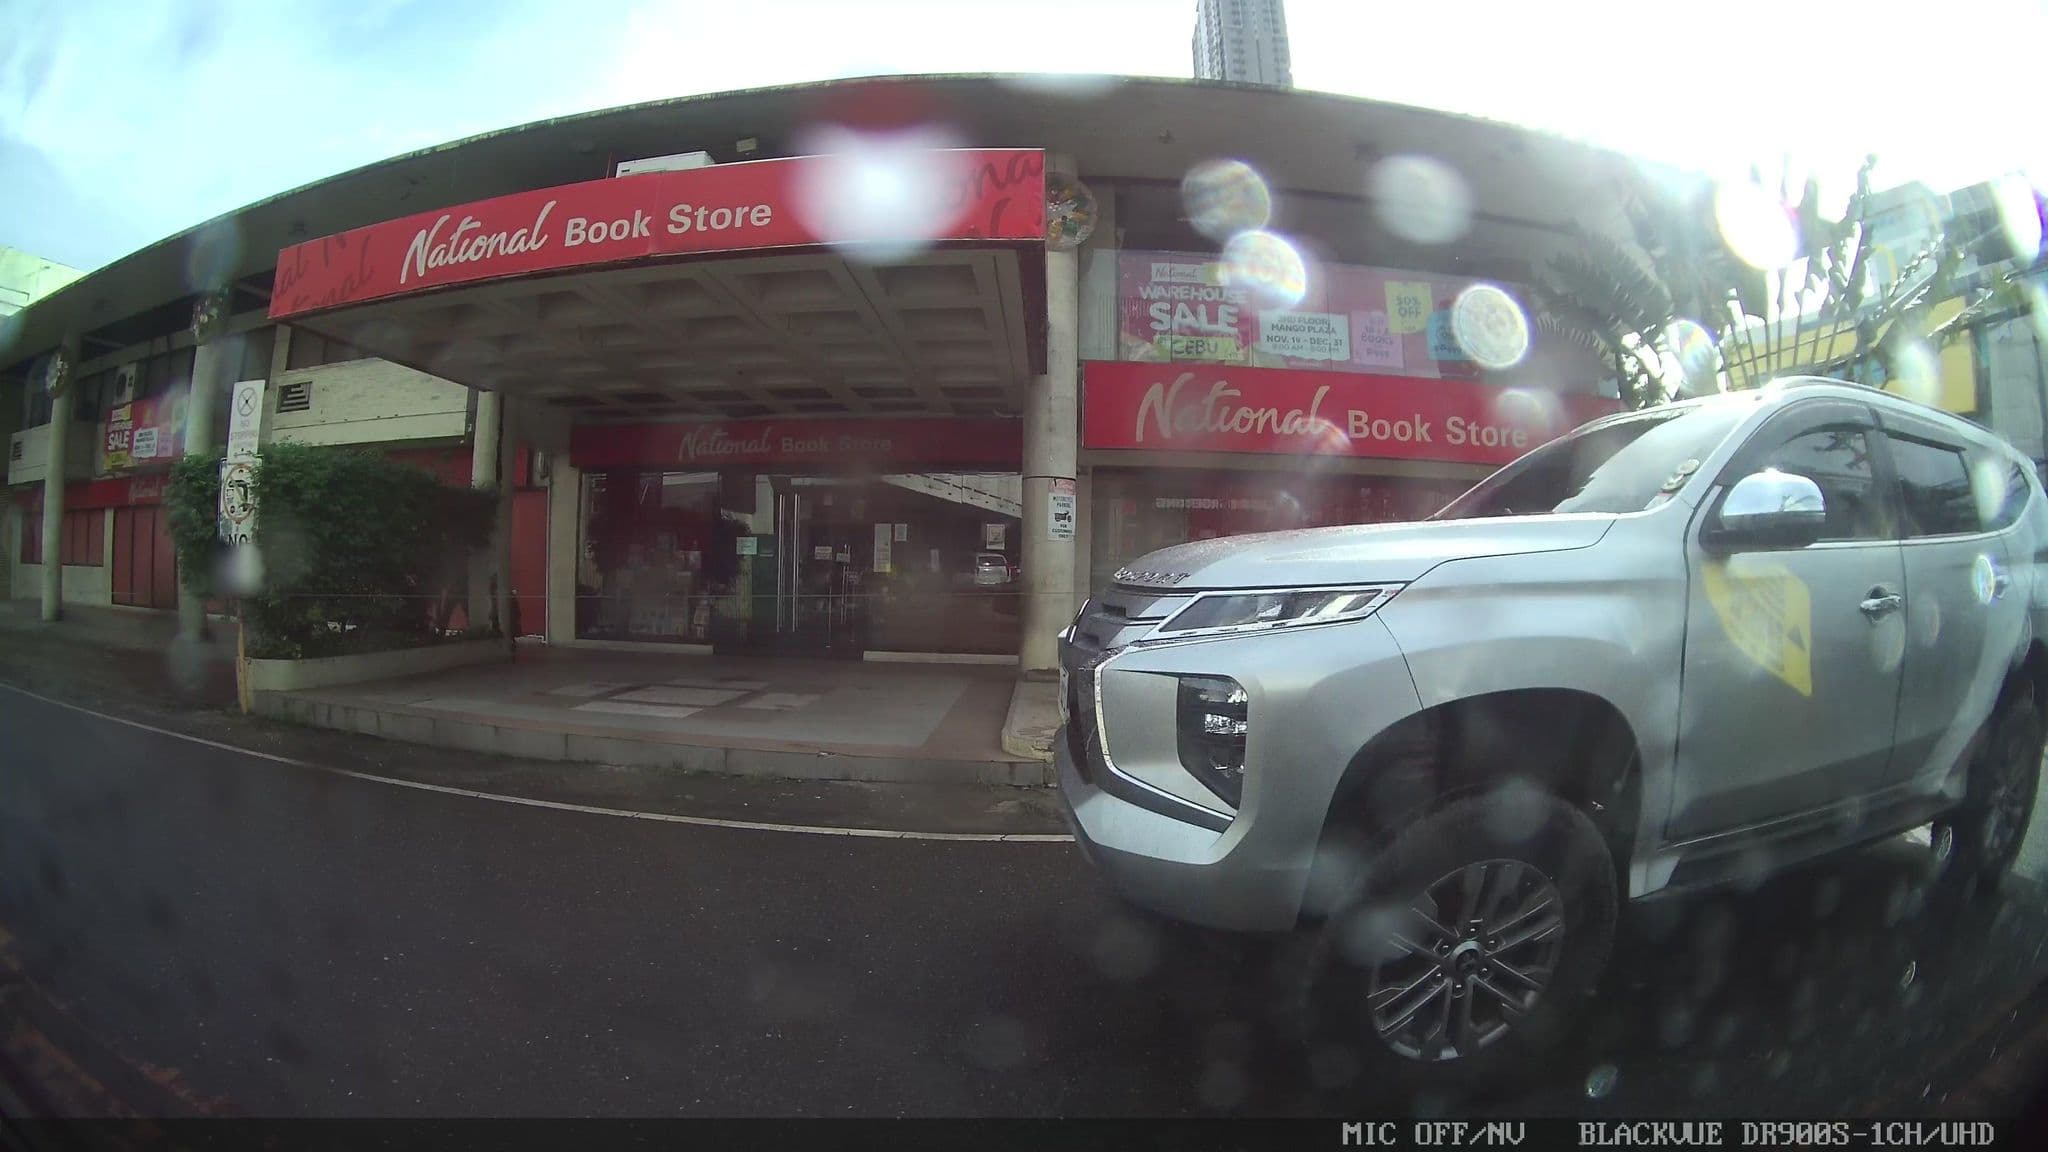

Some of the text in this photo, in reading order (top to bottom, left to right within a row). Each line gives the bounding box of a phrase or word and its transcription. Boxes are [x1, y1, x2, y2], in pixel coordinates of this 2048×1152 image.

[400, 200, 772, 284] National Book Store
[1138, 284, 1247, 304] WAREHOUSE
[1149, 302, 1239, 335] SALE
[1397, 306, 1422, 319] OFF
[1271, 323, 1337, 335] MANGO PLAZA
[1172, 339, 1218, 355] CEBU
[1266, 335, 1289, 344] NOV.
[1135, 372, 1529, 449] National Book Store
[108, 431, 130, 451] SALE
[678, 424, 775, 463] National
[781, 435, 832, 453] Book
